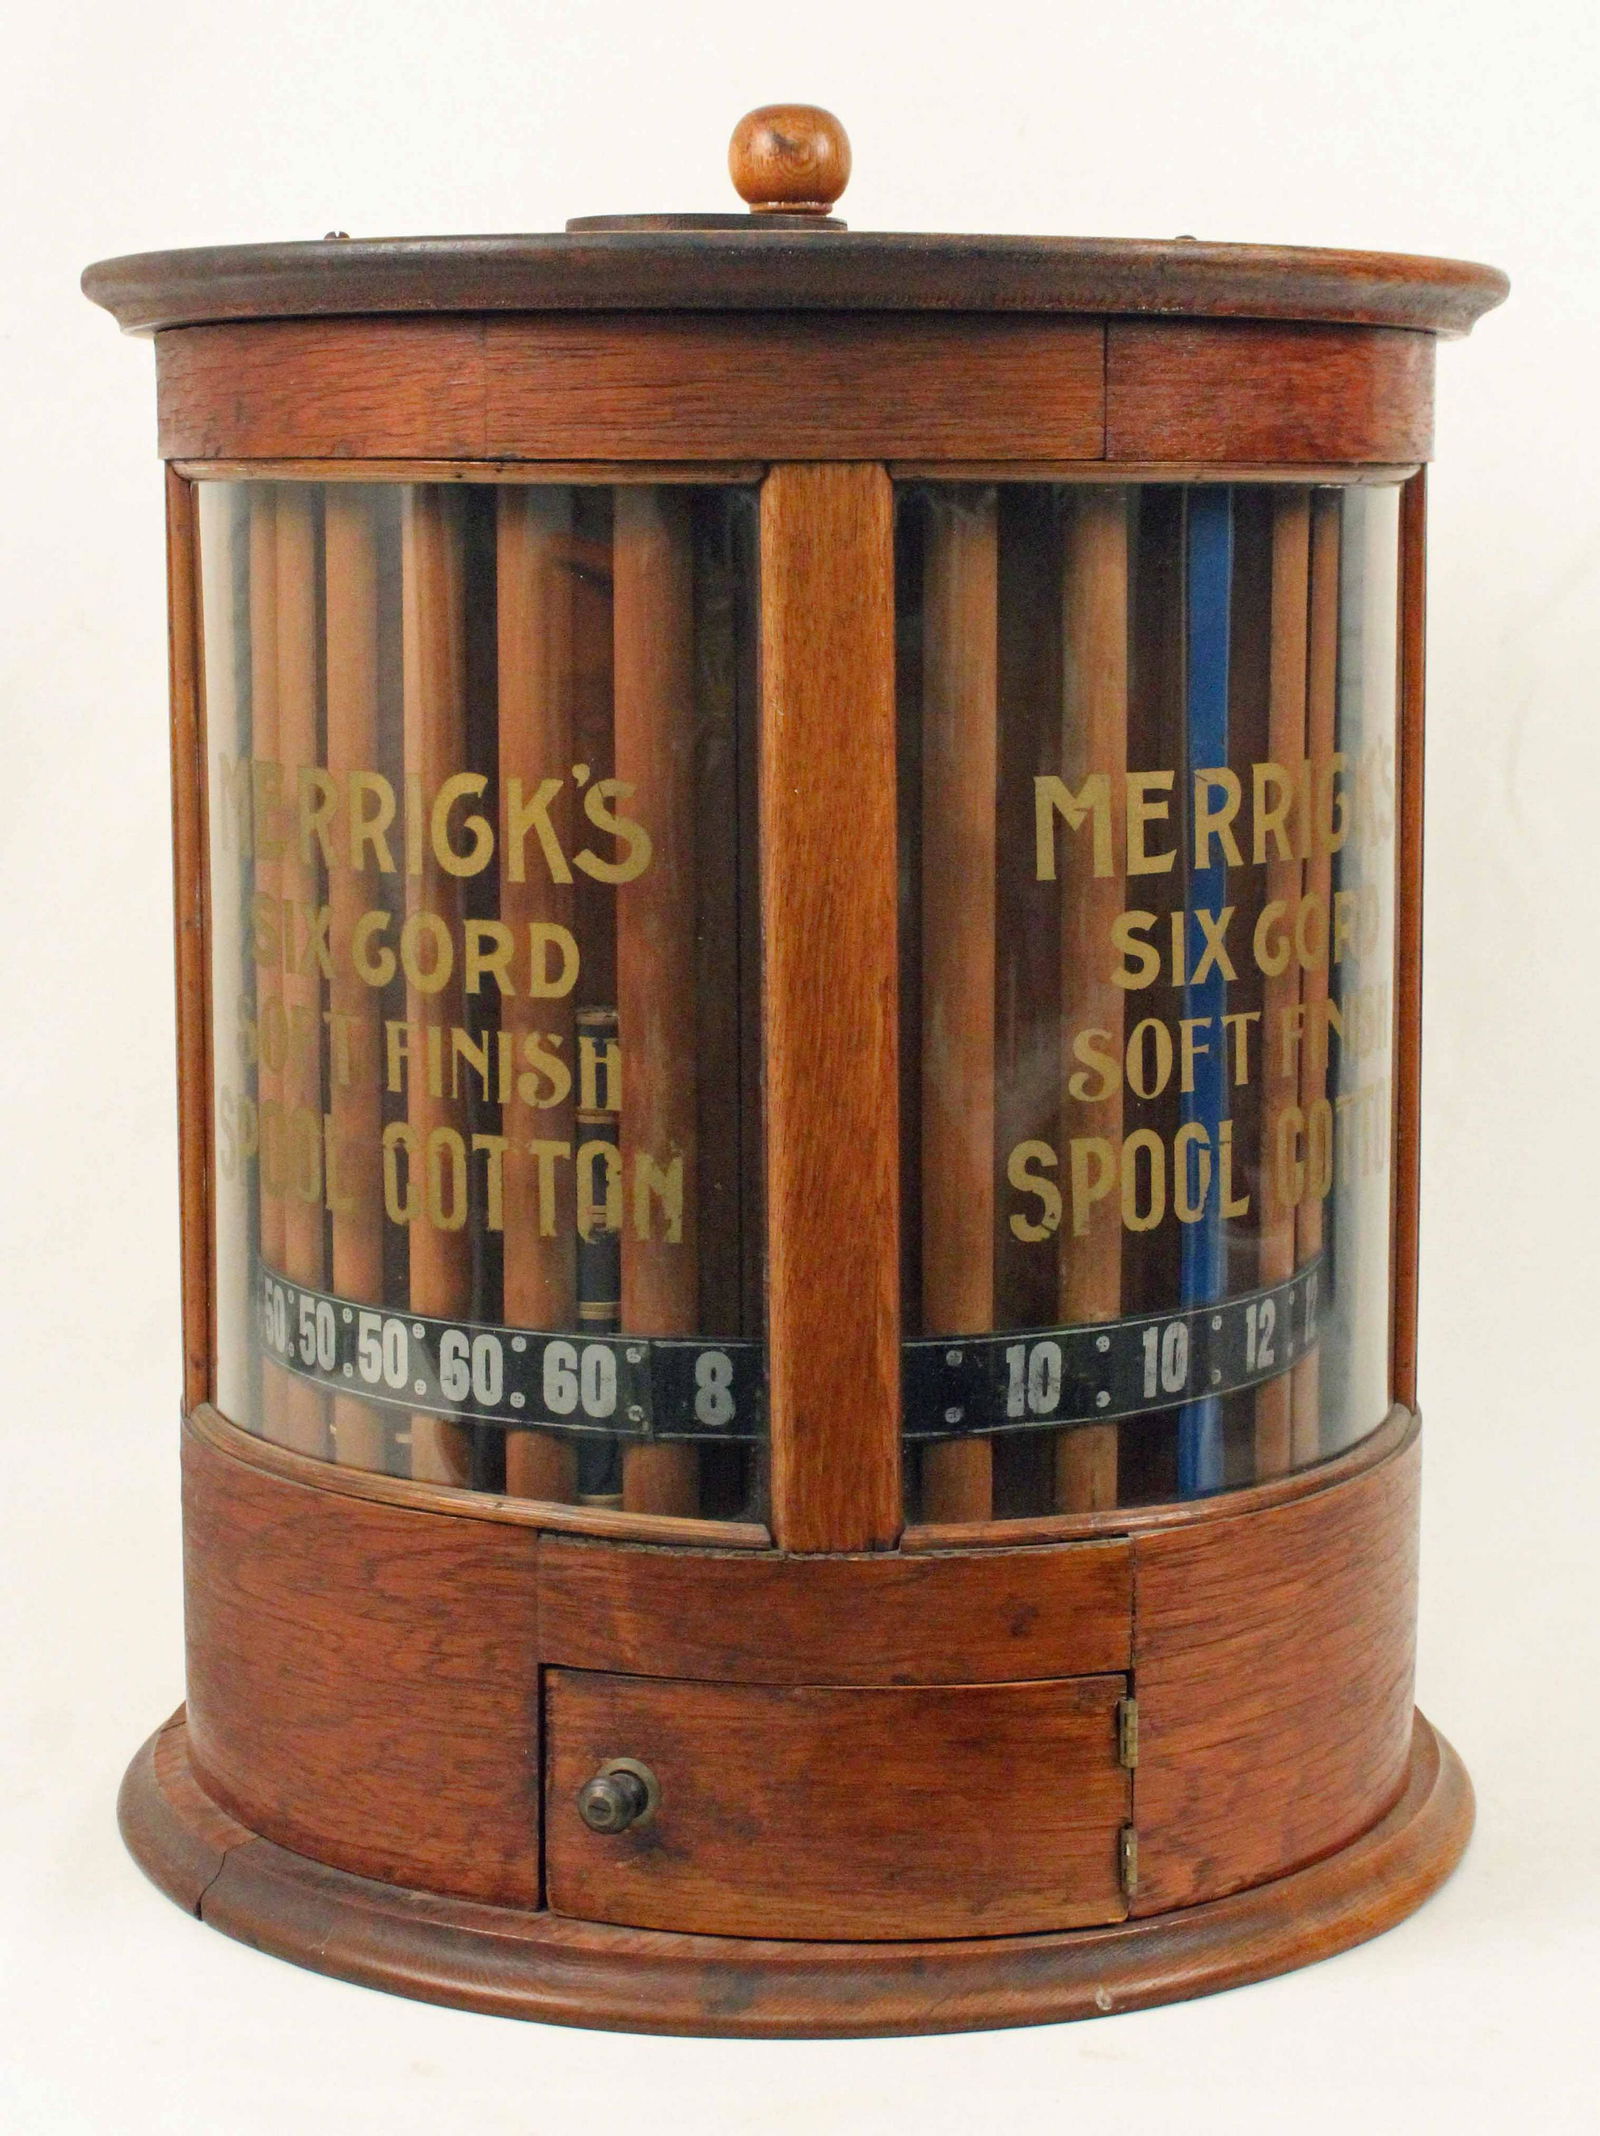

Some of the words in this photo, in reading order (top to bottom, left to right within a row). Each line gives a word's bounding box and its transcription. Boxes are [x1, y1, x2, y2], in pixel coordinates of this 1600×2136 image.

[218, 751, 653, 885] MERRICK'S
[1034, 740, 1393, 881] MERRIC
[249, 891, 336, 979] SIX
[351, 910, 581, 999] CORD
[1110, 906, 1239, 991] SIX
[1253, 884, 1380, 978] CORD
[385, 1020, 622, 1112] FINISH
[1069, 1011, 1261, 1102] SOFT
[382, 1121, 684, 1247] COTTON
[1007, 1119, 1250, 1243] SPOOL
[299, 1294, 336, 1372] 50
[358, 1311, 408, 1390] 50
[439, 1329, 504, 1407] 60
[543, 1340, 617, 1418] 60
[695, 1351, 736, 1427] 8
[1006, 1340, 1062, 1419] 10
[1142, 1321, 1190, 1399] 10
[1245, 1298, 1277, 1373] 12
